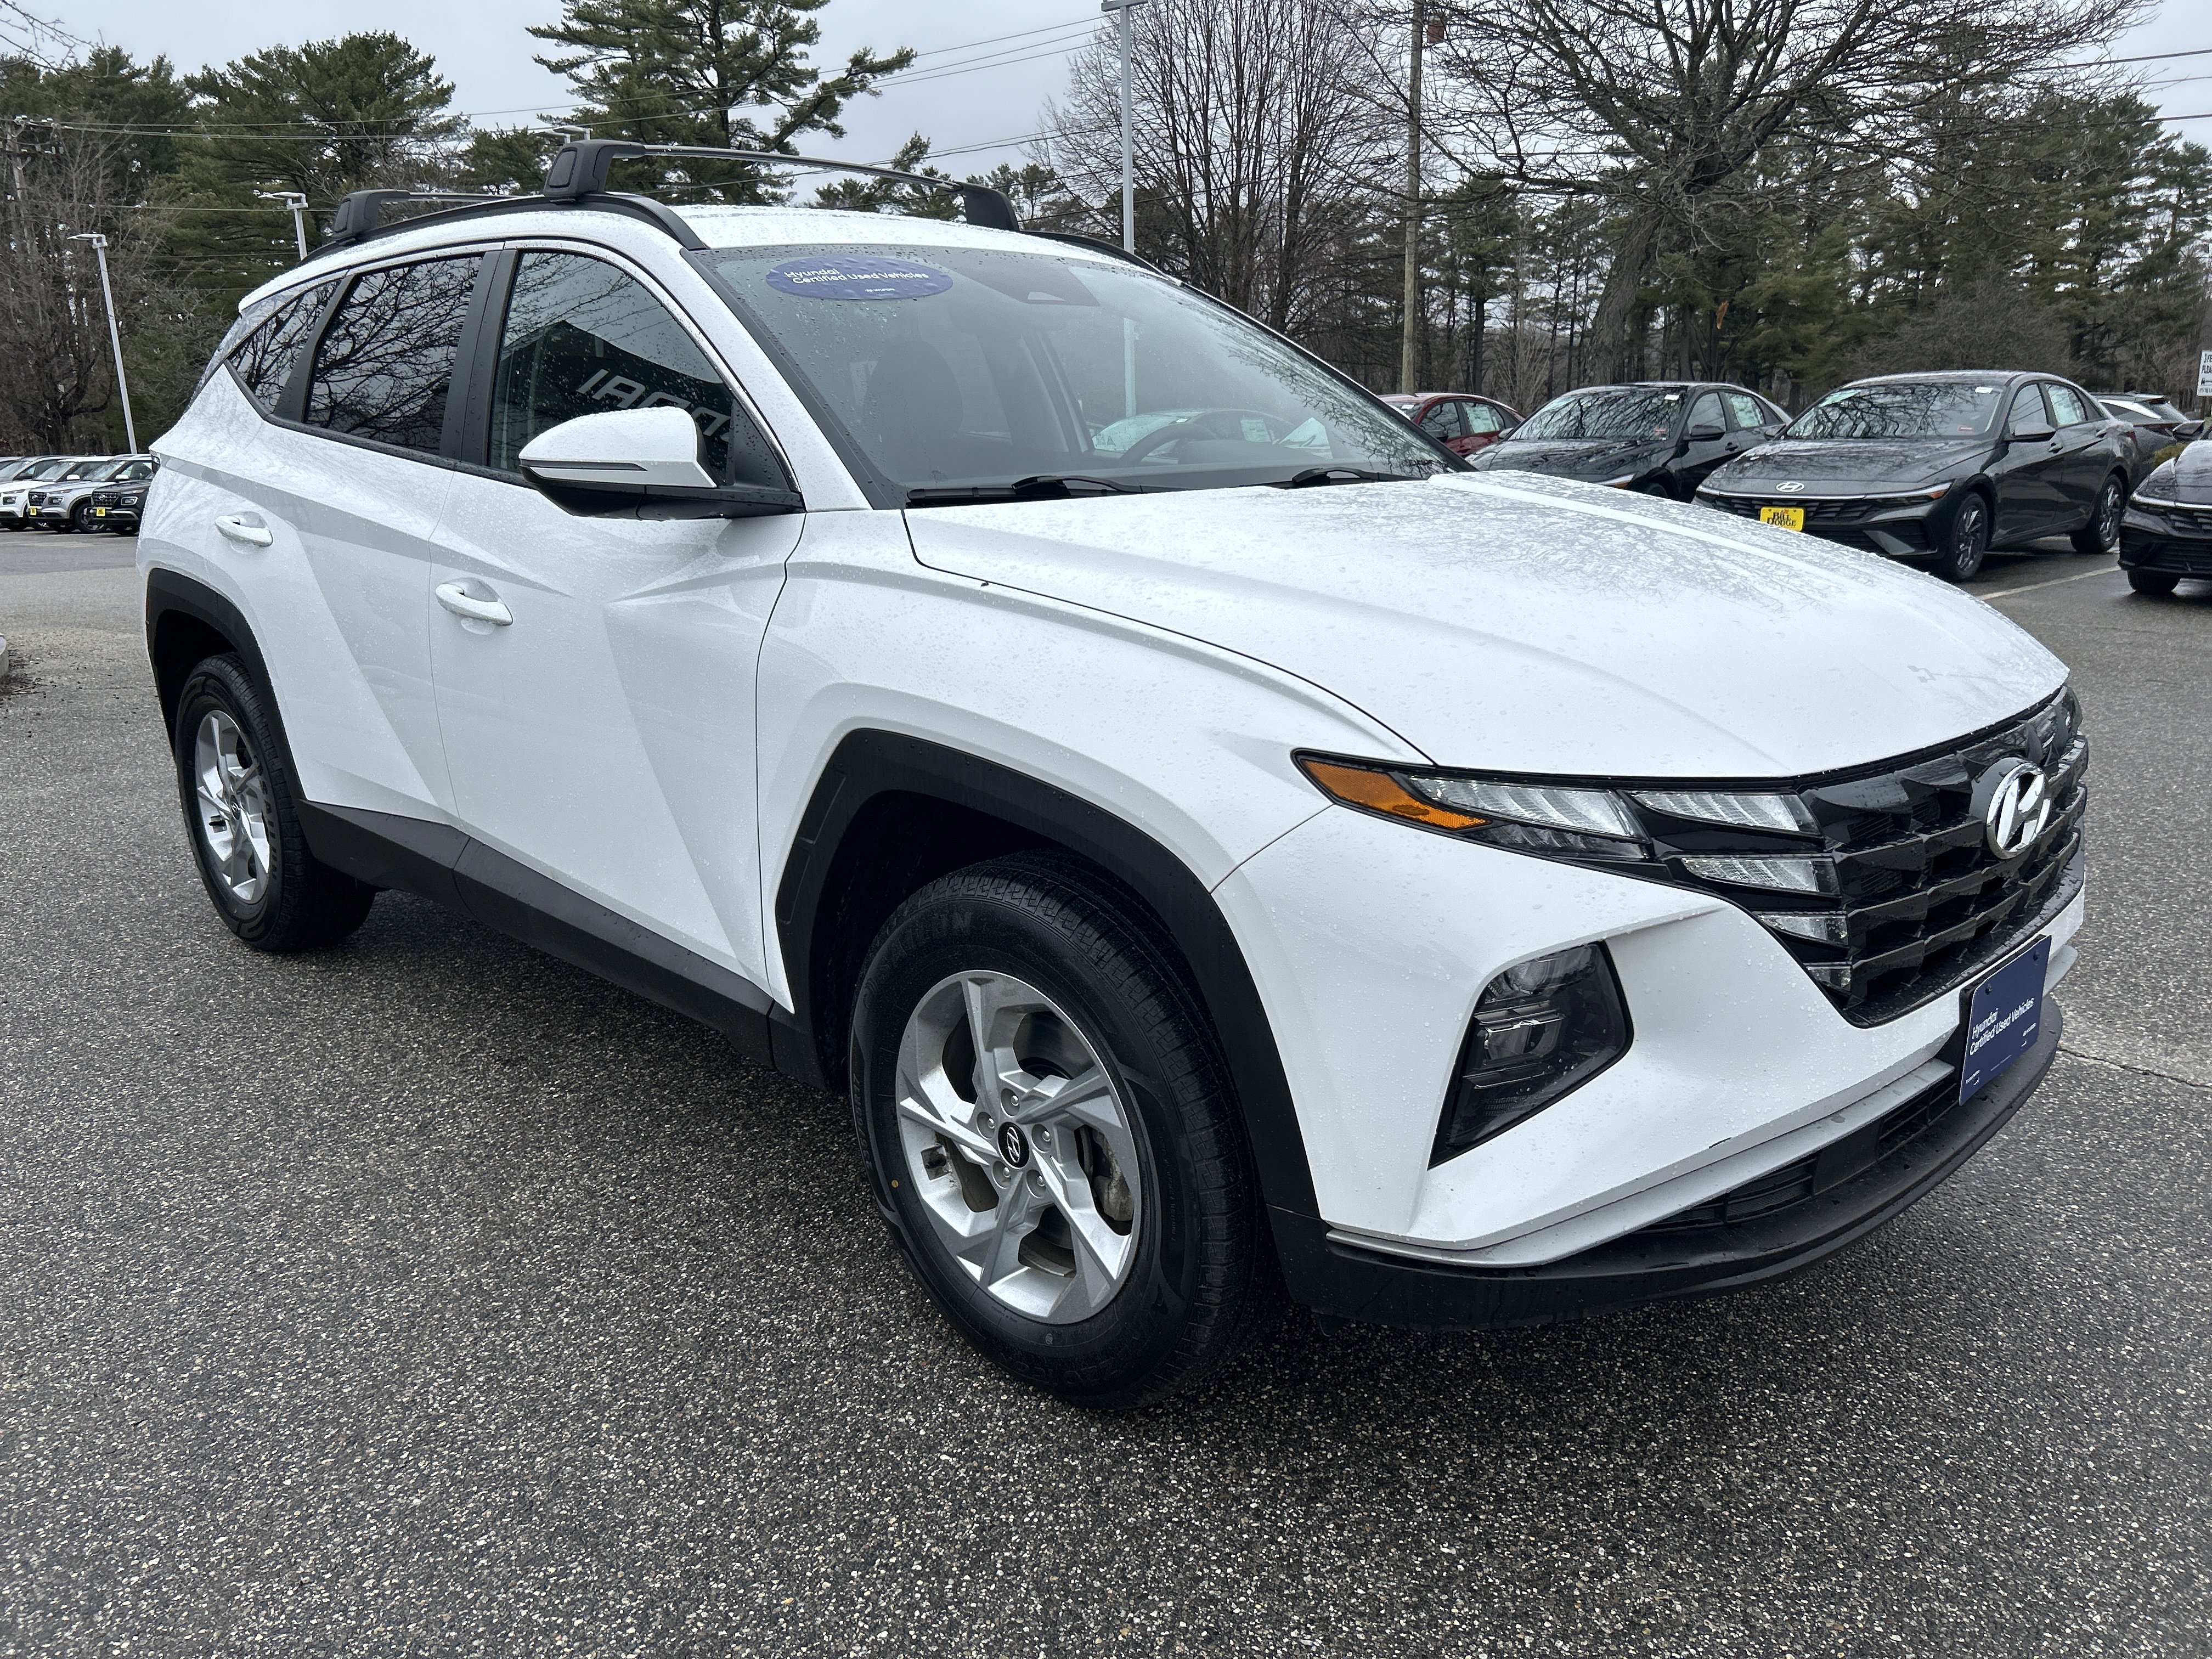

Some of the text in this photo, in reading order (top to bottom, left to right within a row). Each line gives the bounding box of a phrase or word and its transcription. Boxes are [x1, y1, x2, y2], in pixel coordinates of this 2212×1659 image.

[783, 268, 840, 279] Hyundai
[792, 273, 848, 284] Certified
[847, 272, 881, 281] Used
[1970, 1024, 1996, 1056] Certified
[1995, 1012, 2012, 1035] Used
[2011, 997, 2035, 1023] Vehicles
[1972, 1007, 1999, 1040] Hyundai
